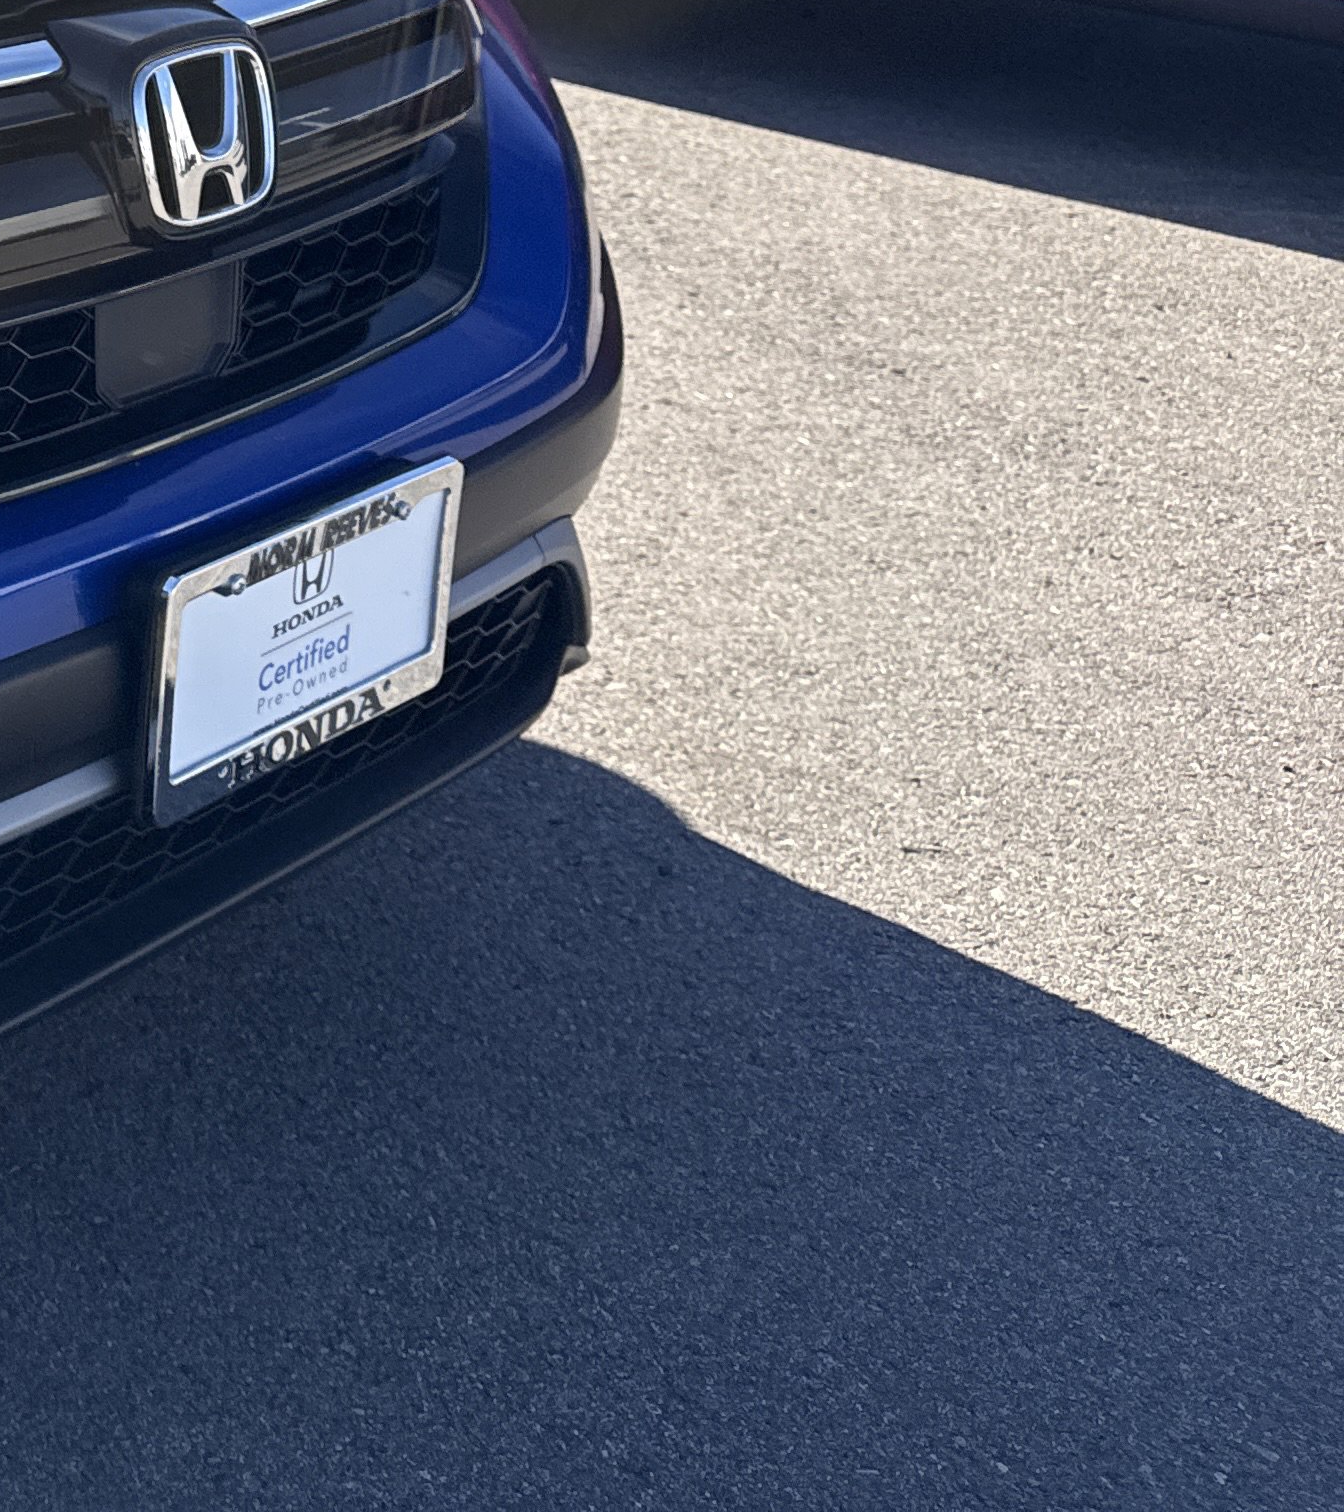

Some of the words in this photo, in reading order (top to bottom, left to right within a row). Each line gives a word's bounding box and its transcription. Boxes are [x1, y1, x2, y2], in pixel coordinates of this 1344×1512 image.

[246, 526, 317, 588] NORM
[319, 491, 397, 552] REEVES
[271, 594, 344, 639] HONDA
[256, 655, 348, 714] Pre-Owned
[258, 623, 351, 691] Certified
[227, 686, 386, 788] HONDA
